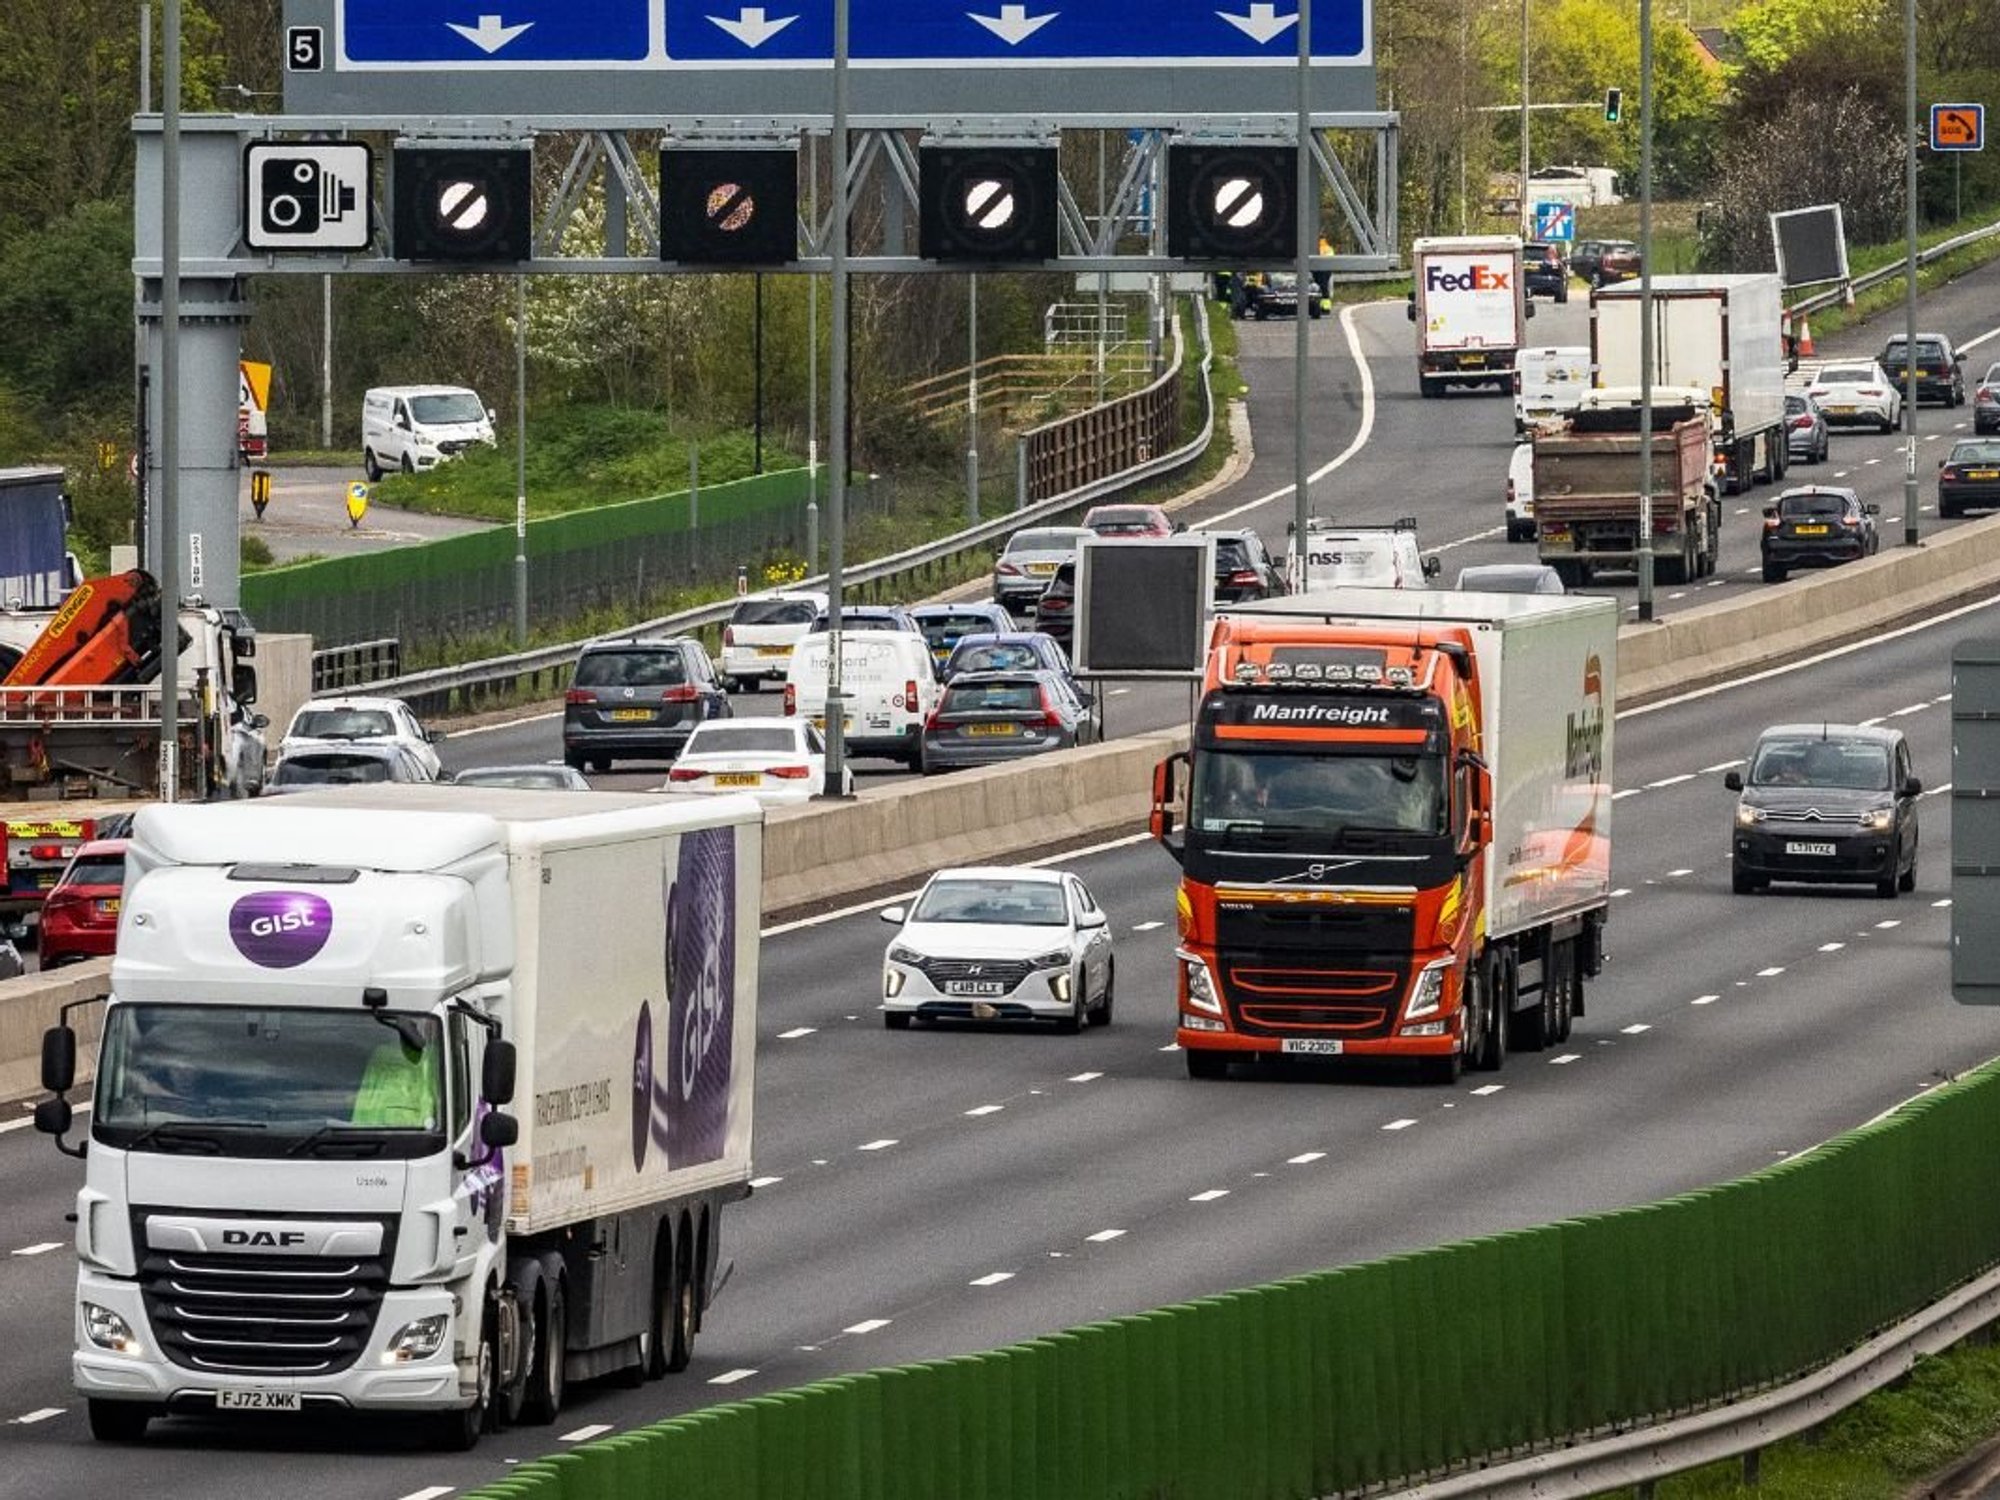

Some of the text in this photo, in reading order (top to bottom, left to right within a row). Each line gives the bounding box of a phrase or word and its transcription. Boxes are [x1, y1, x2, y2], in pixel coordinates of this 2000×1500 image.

[295, 36, 313, 62] 5
[1427, 265, 1509, 291] FedEx
[50, 586, 92, 635] PALFINGER
[1253, 704, 1390, 724] Manfreight
[223, 1230, 305, 1246] DAF
[223, 1391, 262, 1407] FJ72
